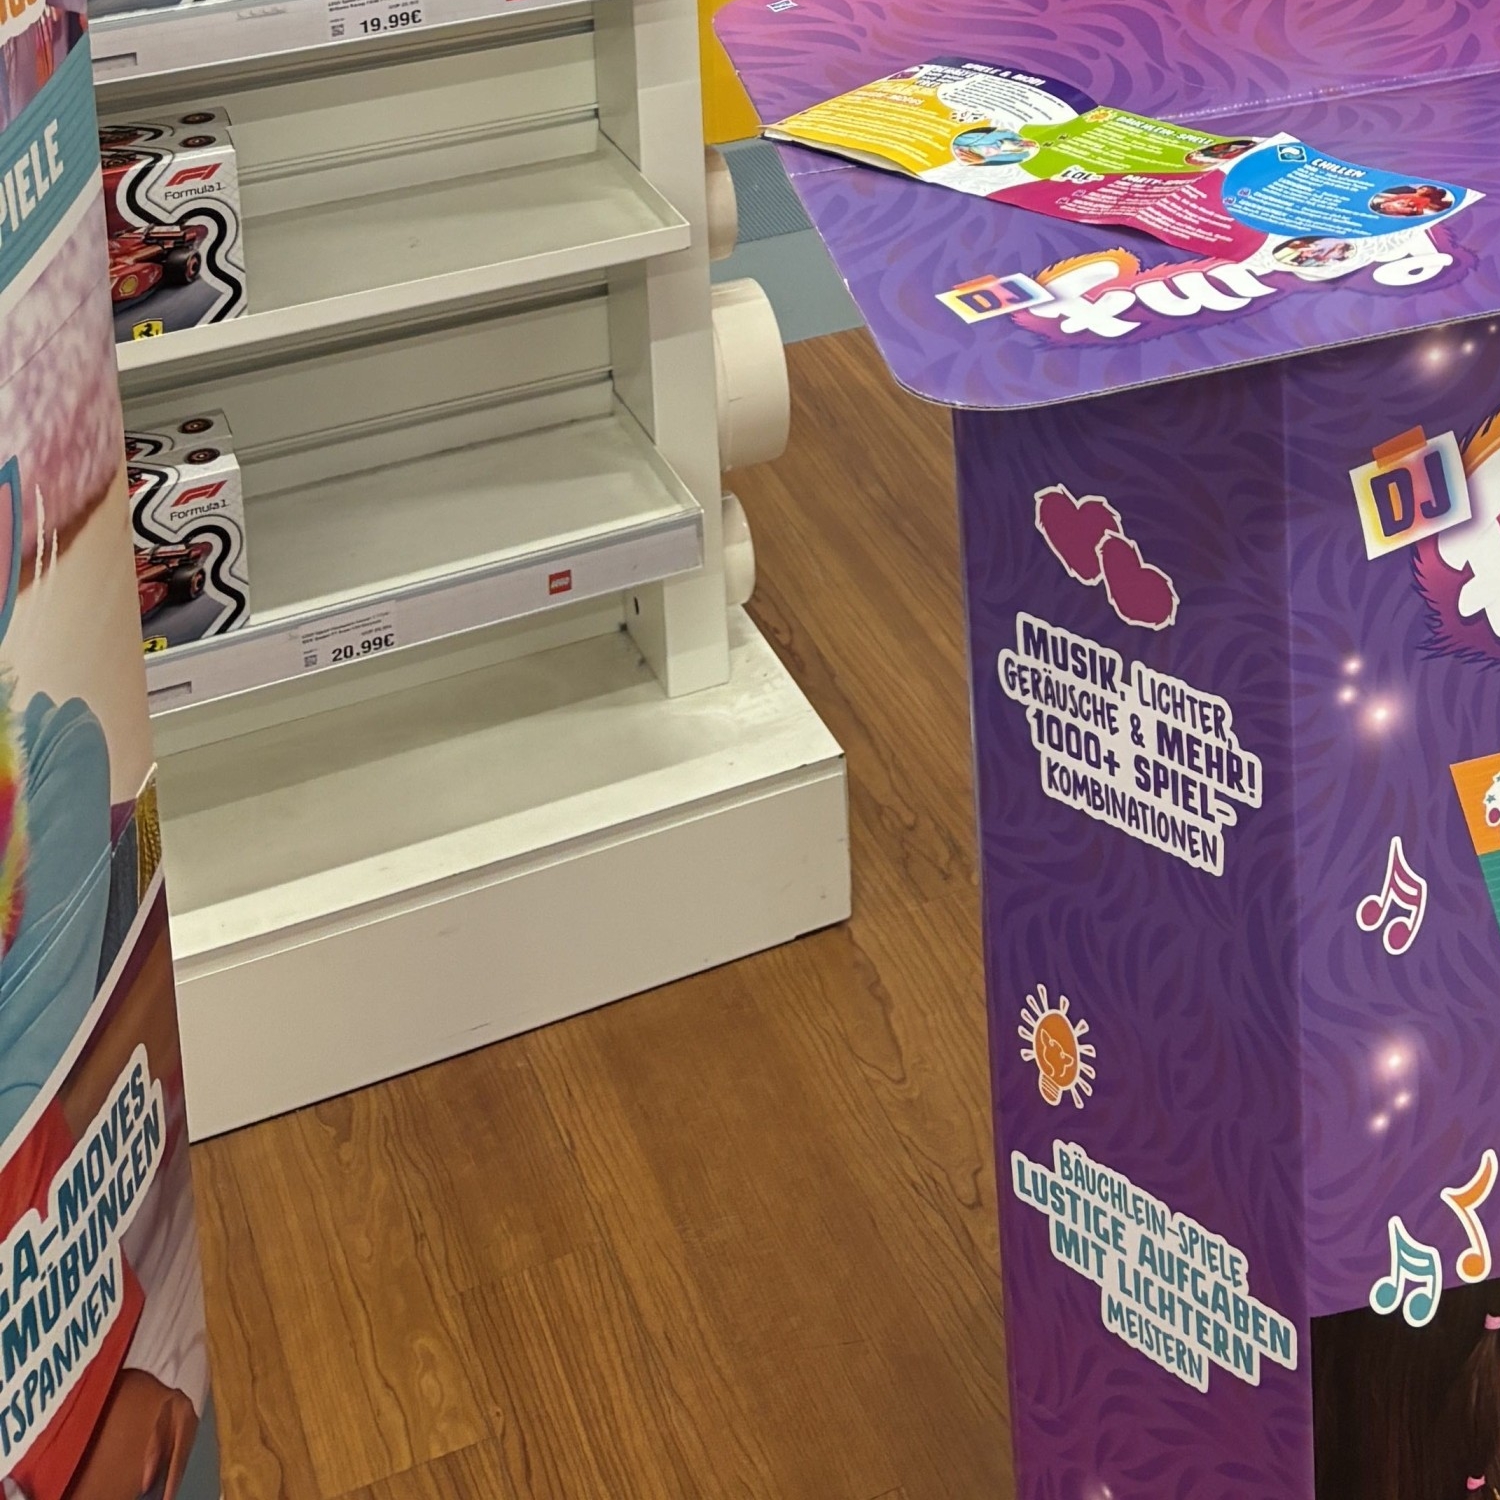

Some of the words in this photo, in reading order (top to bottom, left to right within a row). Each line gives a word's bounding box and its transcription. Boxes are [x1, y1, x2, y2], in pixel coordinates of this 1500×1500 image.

[359, 9, 423, 34] 19.99€
[1311, 158, 1367, 179] CHILLEN
[957, 278, 1037, 314] DJ
[1370, 451, 1453, 537] DJ
[331, 633, 395, 663] 20.99€
[1022, 621, 1128, 700] MUSIK,
[1136, 671, 1234, 749] LICHTER,
[1003, 658, 1120, 734] GERÄUSCHE
[1130, 714, 1145, 749] &
[1156, 722, 1258, 799] MEHR!
[1031, 711, 1121, 777] 1000+
[1134, 759, 1236, 823] SPIEL-
[1046, 762, 1219, 864] KOMBINATIONEN
[0, 1063, 146, 1321] A-MOVES
[0, 1099, 161, 1394] MÜBUNGEN
[1059, 1146, 1243, 1290] BÄUCHLEIN-SPIELE
[1016, 1160, 1127, 1255] LUSTIGE
[1137, 1239, 1292, 1361] AUFGABEN
[1053, 1226, 1107, 1281] MIT
[1118, 1267, 1254, 1377] LICHTERN
[1106, 1299, 1204, 1384] MEISTERN
